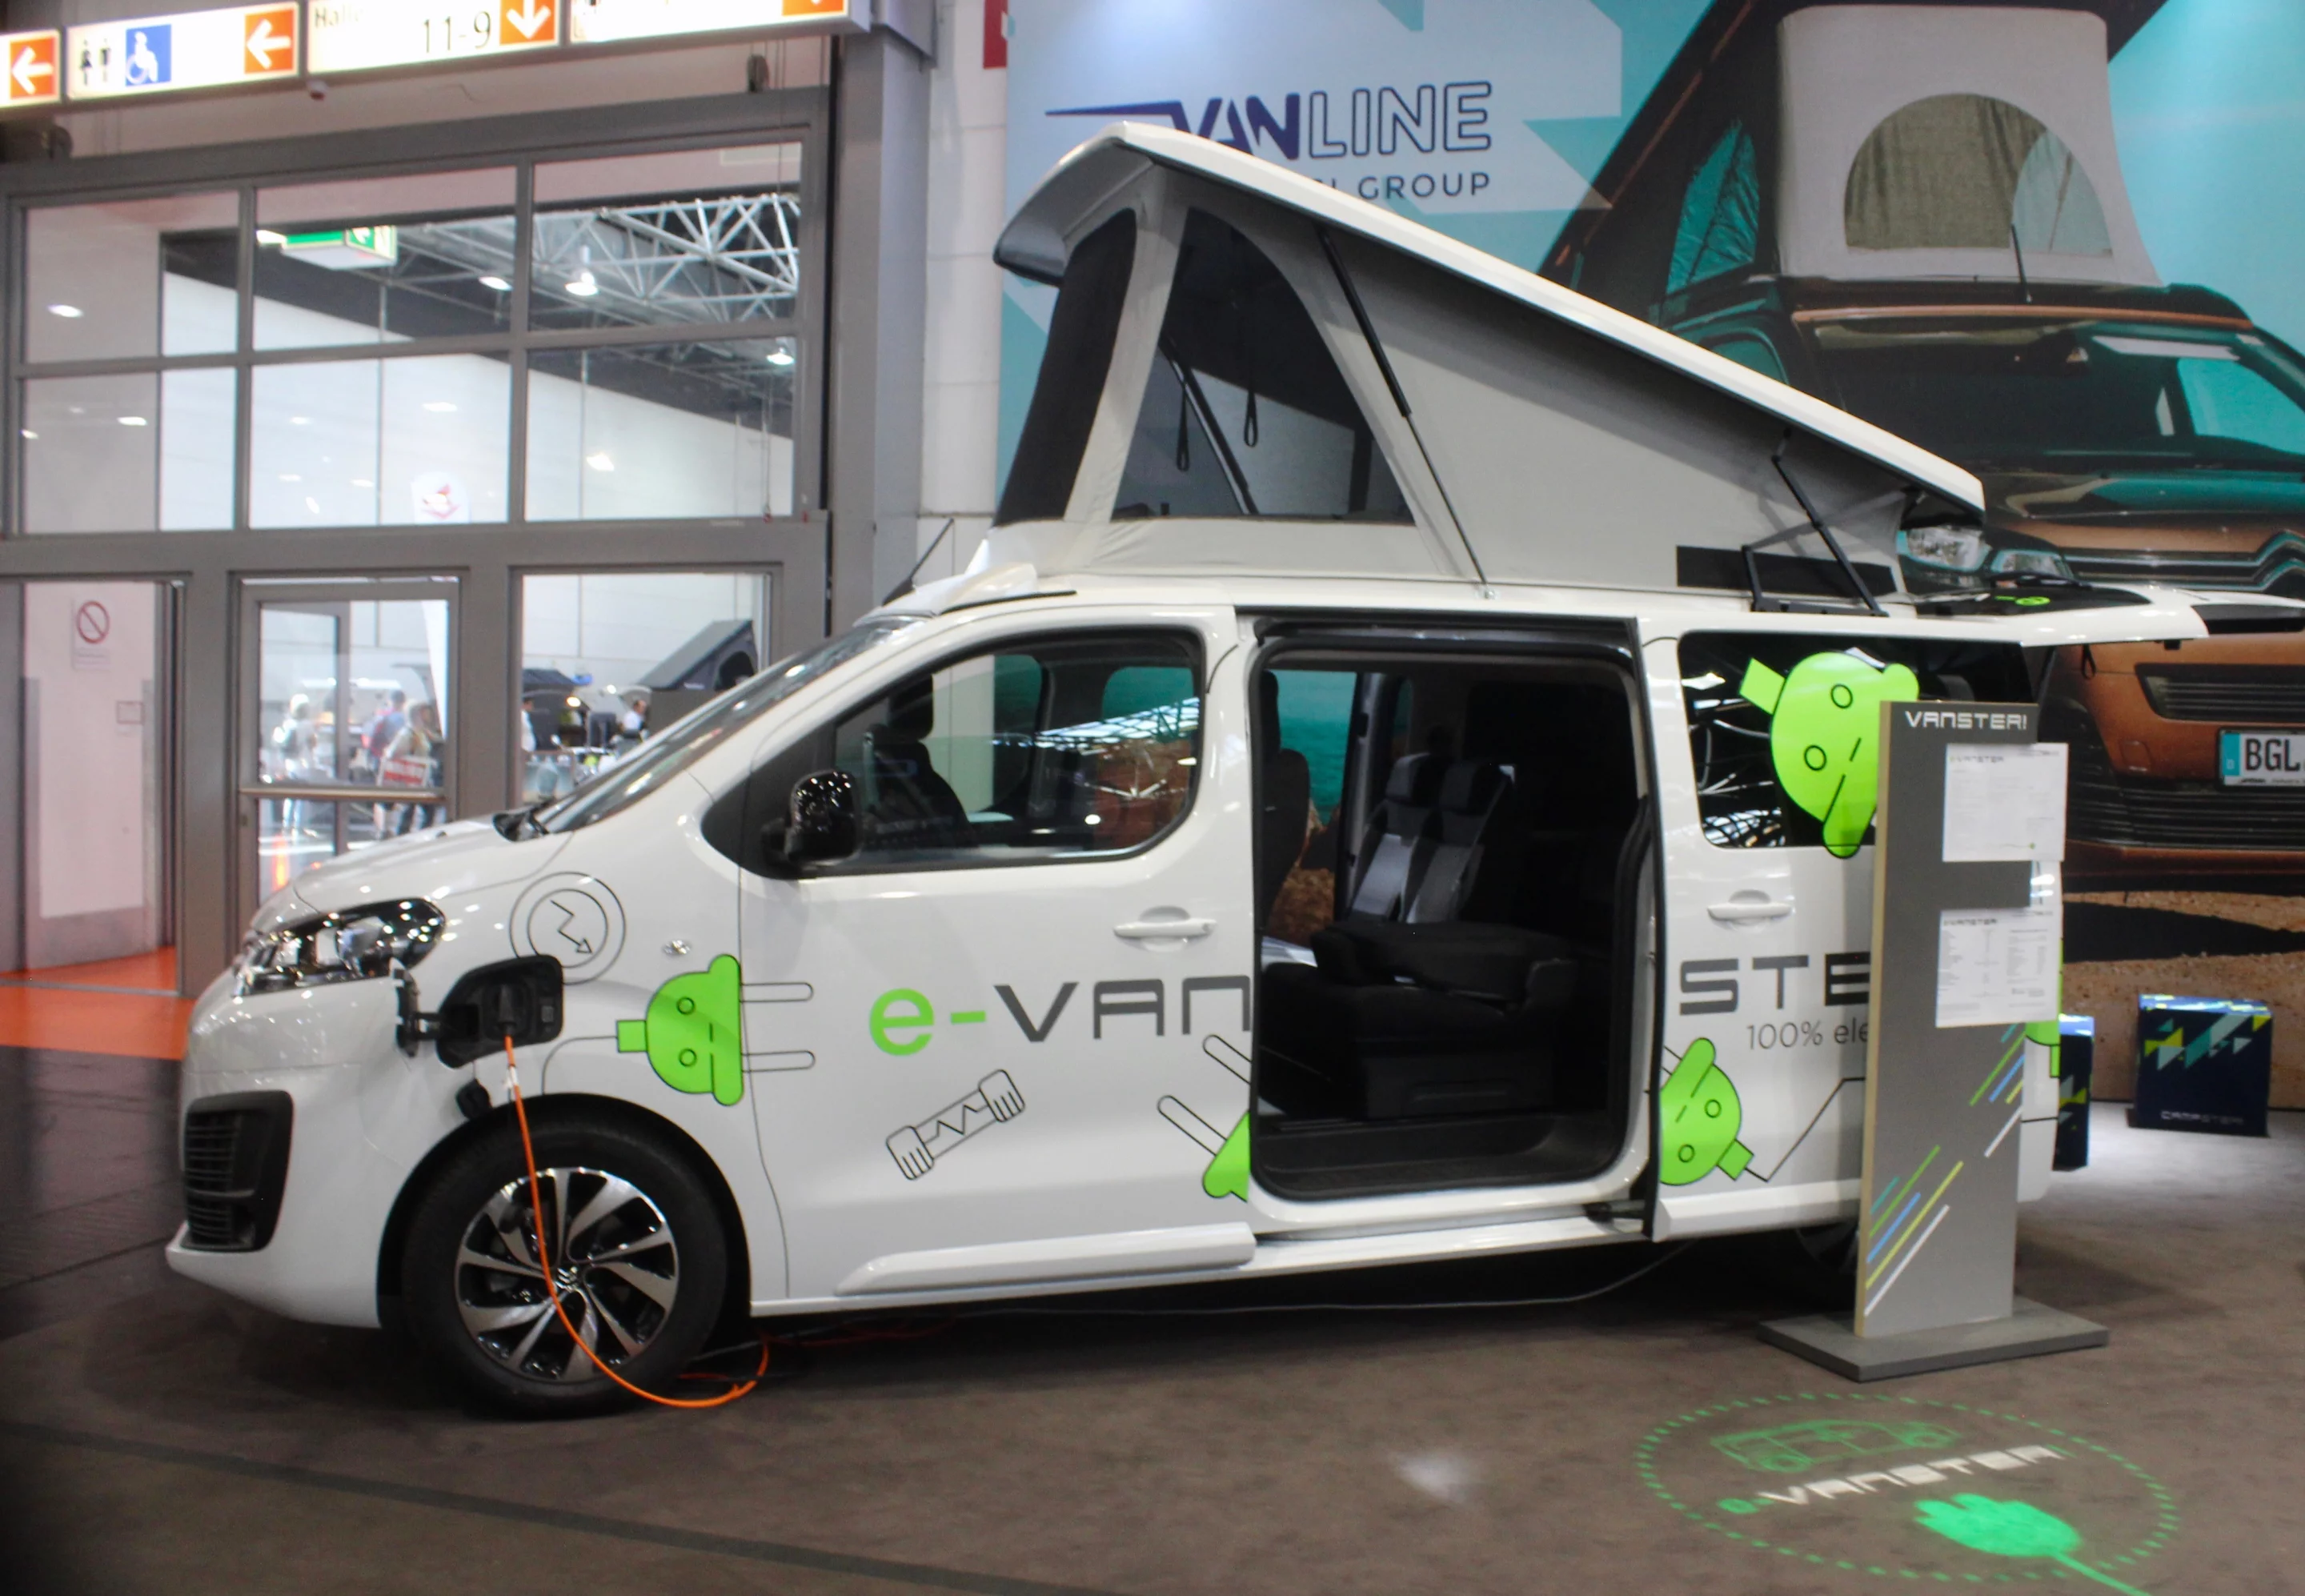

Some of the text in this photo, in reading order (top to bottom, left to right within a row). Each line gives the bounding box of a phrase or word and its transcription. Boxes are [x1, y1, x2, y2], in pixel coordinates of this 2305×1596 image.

[423, 11, 491, 53] 11-9
[1358, 172, 1489, 200] GROUP
[2245, 738, 2301, 772] BGL
[1679, 952, 1871, 1016] STE
[1746, 1017, 1870, 1050] 100% ele
